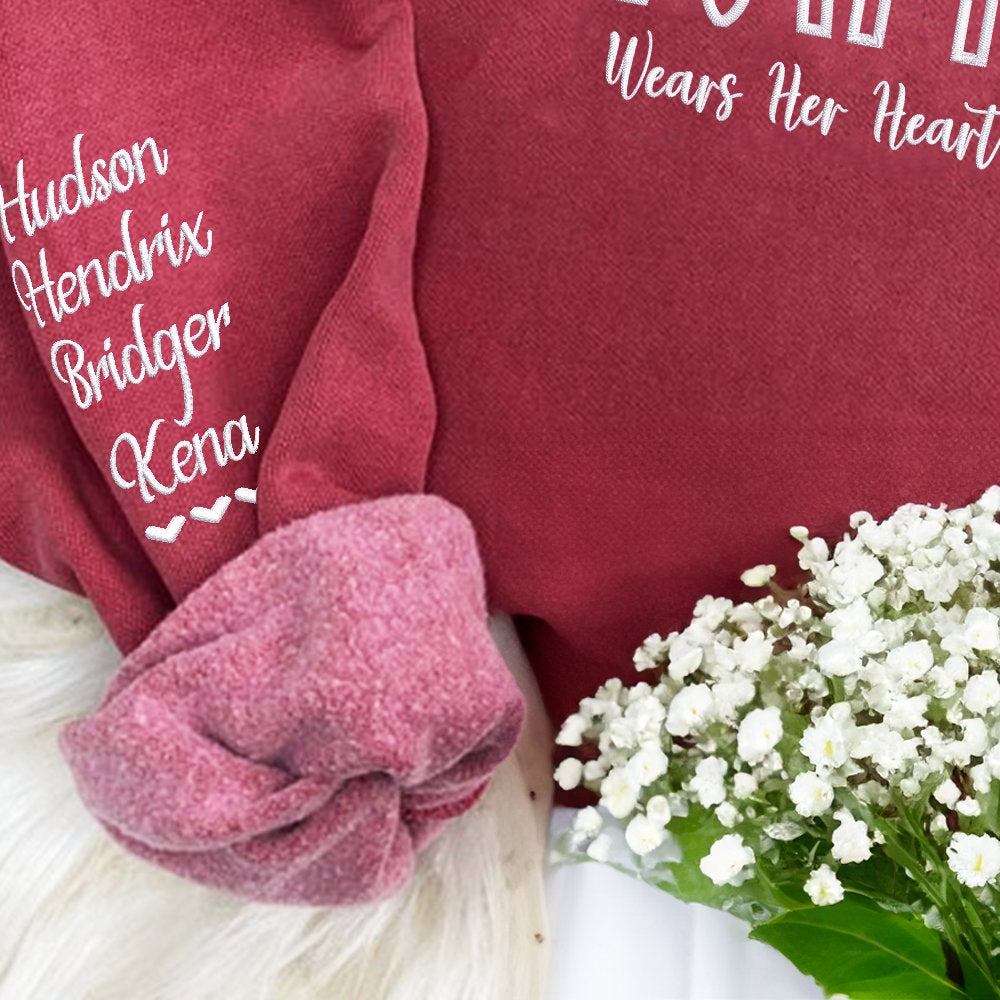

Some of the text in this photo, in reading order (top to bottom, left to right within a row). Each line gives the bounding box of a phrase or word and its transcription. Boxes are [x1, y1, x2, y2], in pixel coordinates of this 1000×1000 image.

[605, 30, 743, 121] Wears
[769, 62, 848, 136] Her
[0, 134, 168, 244] Hudson
[12, 210, 212, 328] Hendrix
[51, 302, 230, 427] Bridger
[110, 415, 260, 503] Kena
